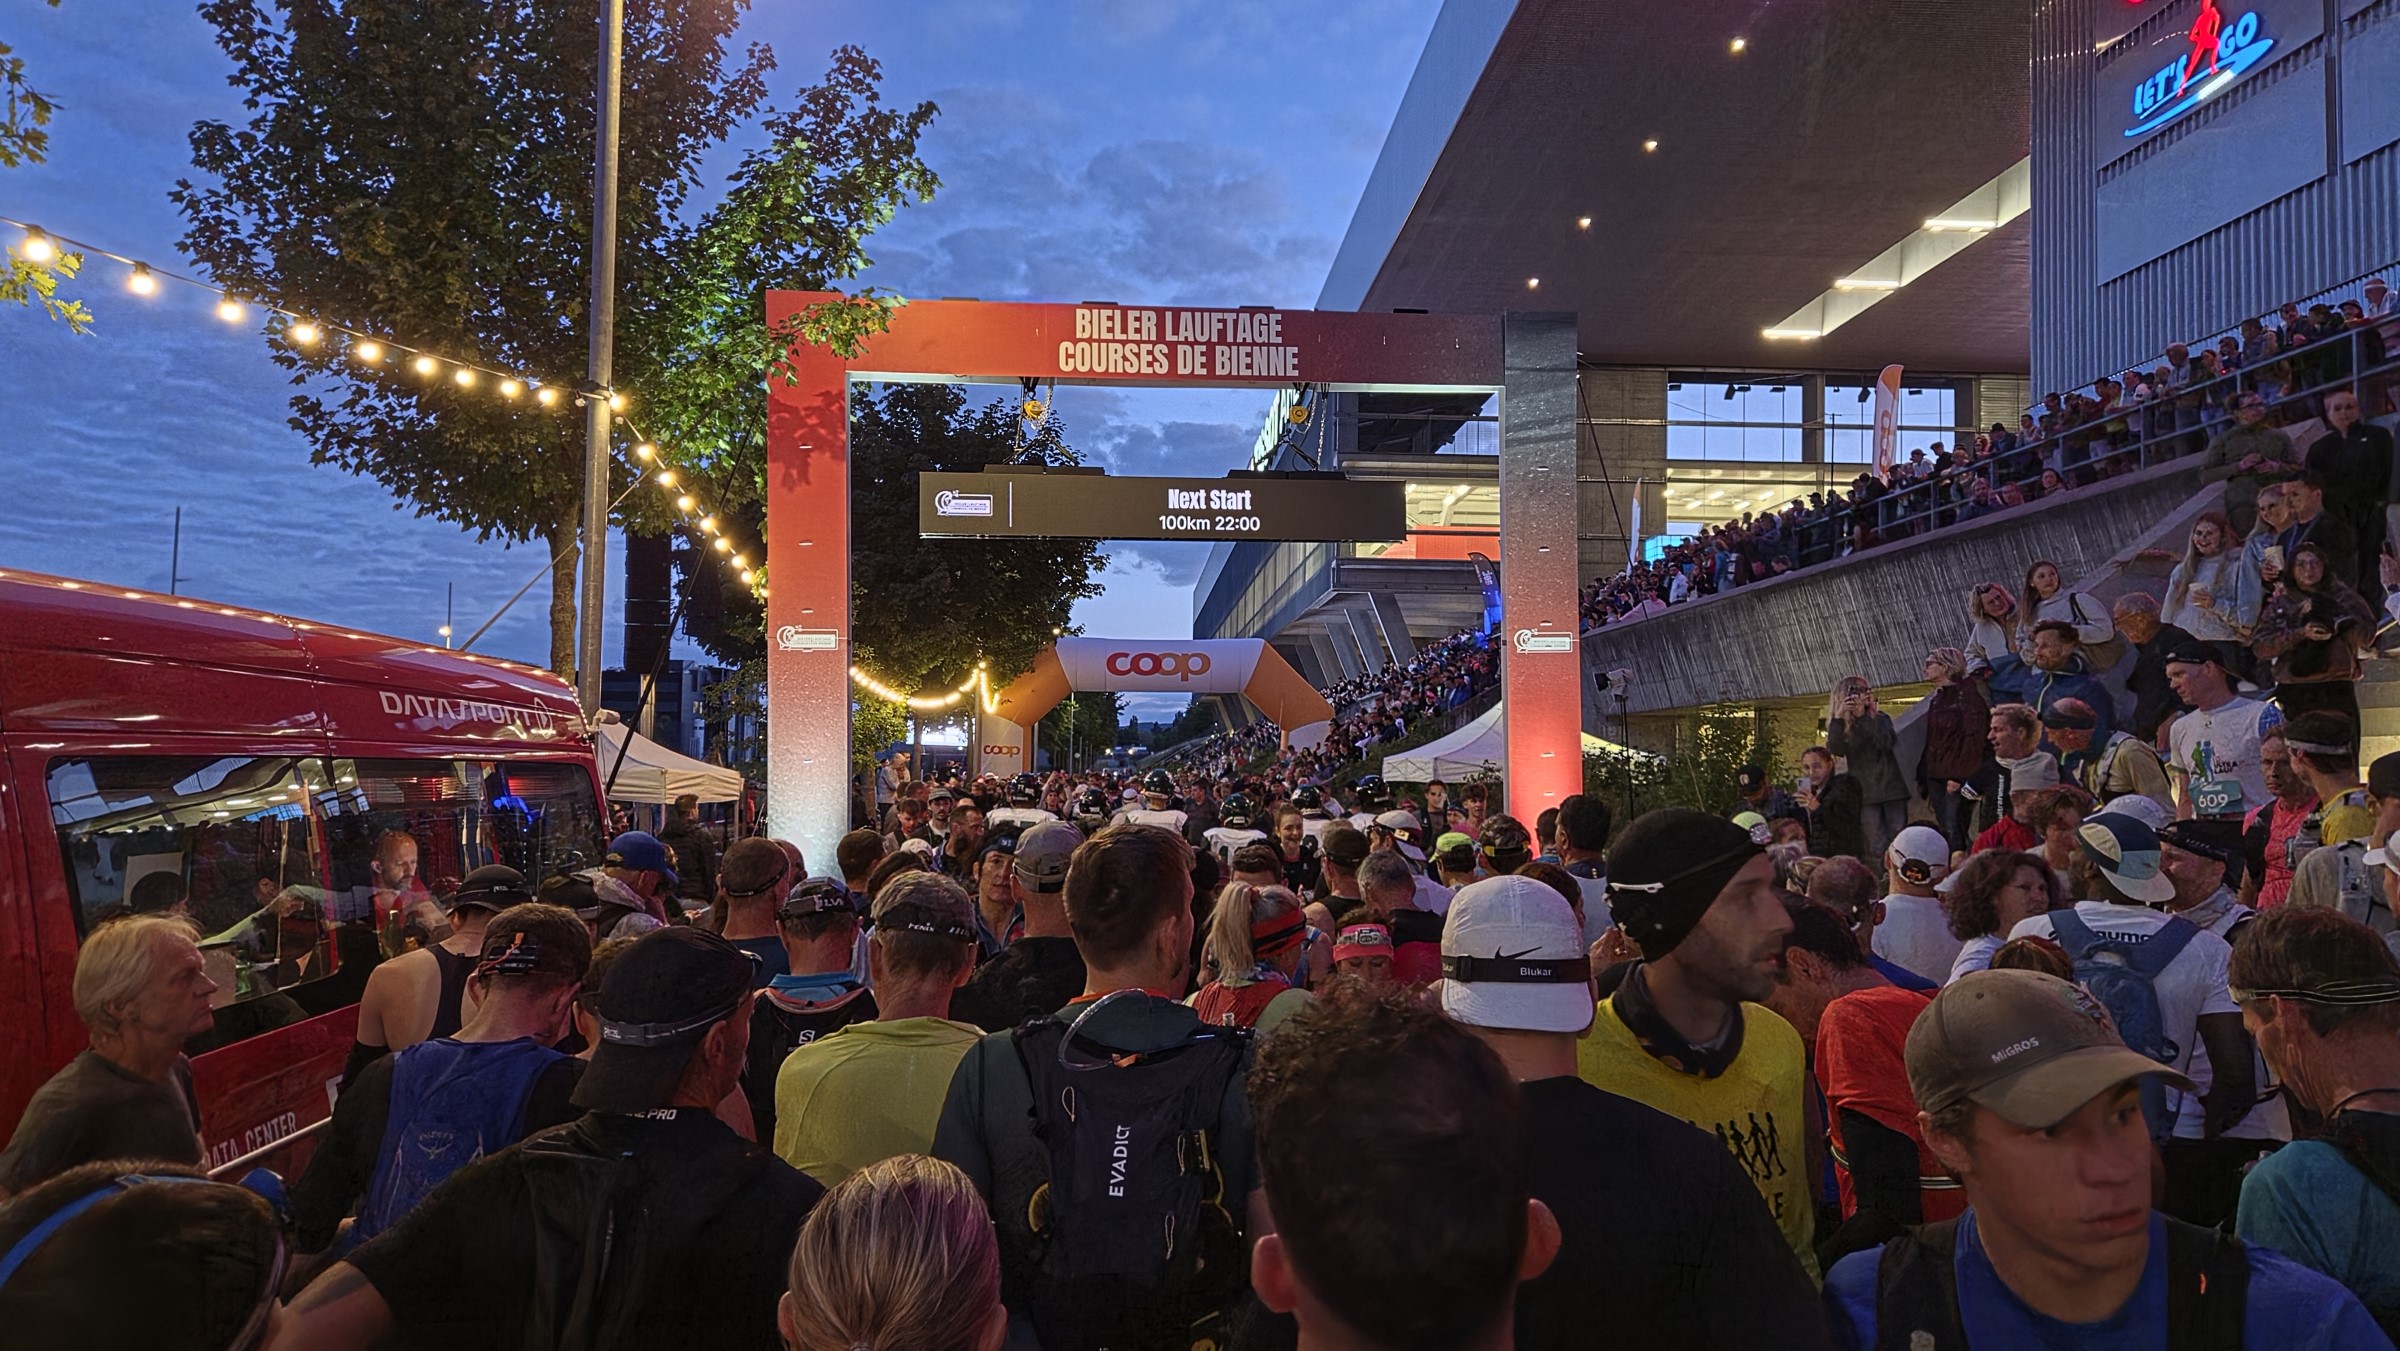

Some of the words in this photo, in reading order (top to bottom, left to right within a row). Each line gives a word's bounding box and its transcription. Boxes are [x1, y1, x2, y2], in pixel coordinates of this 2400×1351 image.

[2134, 54, 2187, 114] LET'S
[2218, 12, 2258, 59] GO
[1076, 309, 1157, 340] BIELER
[1165, 311, 1282, 344] LAUFTAGE
[1058, 341, 1169, 374] COURSES
[1177, 345, 1207, 375] DE
[1215, 346, 1299, 377] BIENNE
[1168, 489, 1206, 509] Next
[1210, 489, 1252, 510] Start
[1159, 515, 1210, 530] 100km
[1215, 516, 1260, 531] 22:00
[1106, 652, 1211, 682] coop
[379, 691, 531, 727] DATASPORT
[984, 745, 1020, 757] coop
[2198, 793, 2228, 808] 609
[1520, 967, 1552, 976] Blukar
[1991, 1037, 2039, 1063] MIGROS
[647, 1108, 677, 1120] PRO
[245, 1111, 298, 1150] CENTER
[1109, 1125, 1131, 1197] EVADICT
